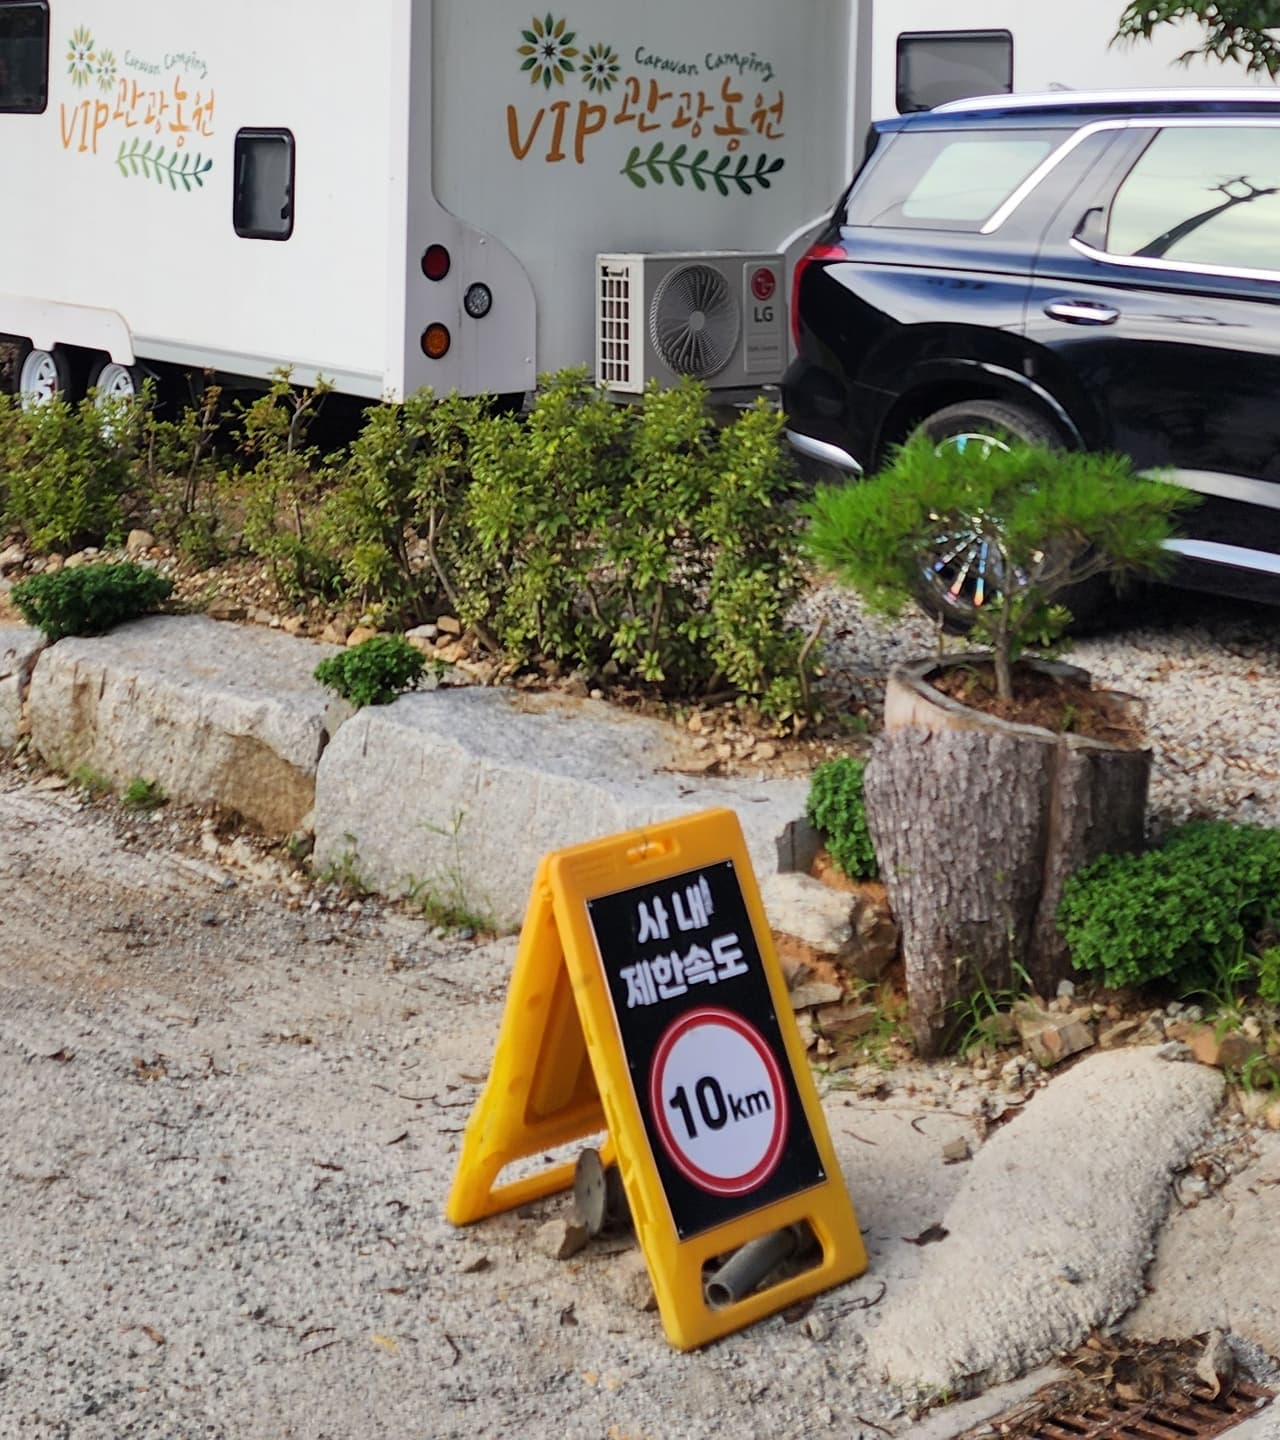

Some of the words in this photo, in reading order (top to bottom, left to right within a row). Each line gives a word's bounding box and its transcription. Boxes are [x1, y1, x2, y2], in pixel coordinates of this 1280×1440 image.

[634, 45, 699, 76] Caravan
[704, 51, 776, 83] Camping
[753, 306, 774, 324] LG
[618, 931, 750, 1009] 제한속도
